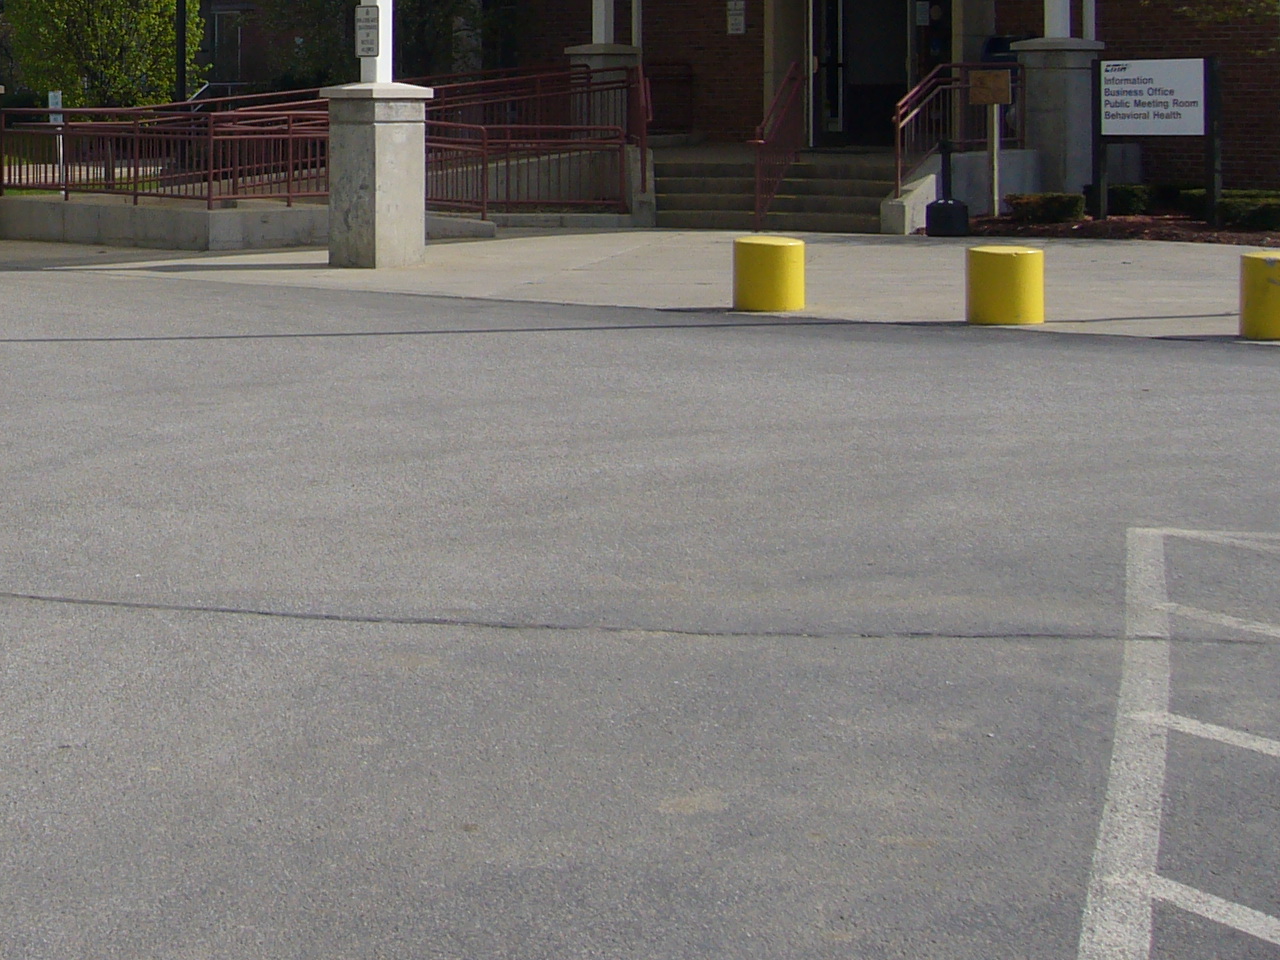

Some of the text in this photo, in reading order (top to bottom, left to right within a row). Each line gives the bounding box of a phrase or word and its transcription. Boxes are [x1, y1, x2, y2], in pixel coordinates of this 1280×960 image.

[1104, 76, 1153, 85] Information
[1104, 87, 1175, 96] Business Office
[1104, 99, 1198, 109] Public Meeting Room
[1104, 111, 1182, 120] Behavioral Health
